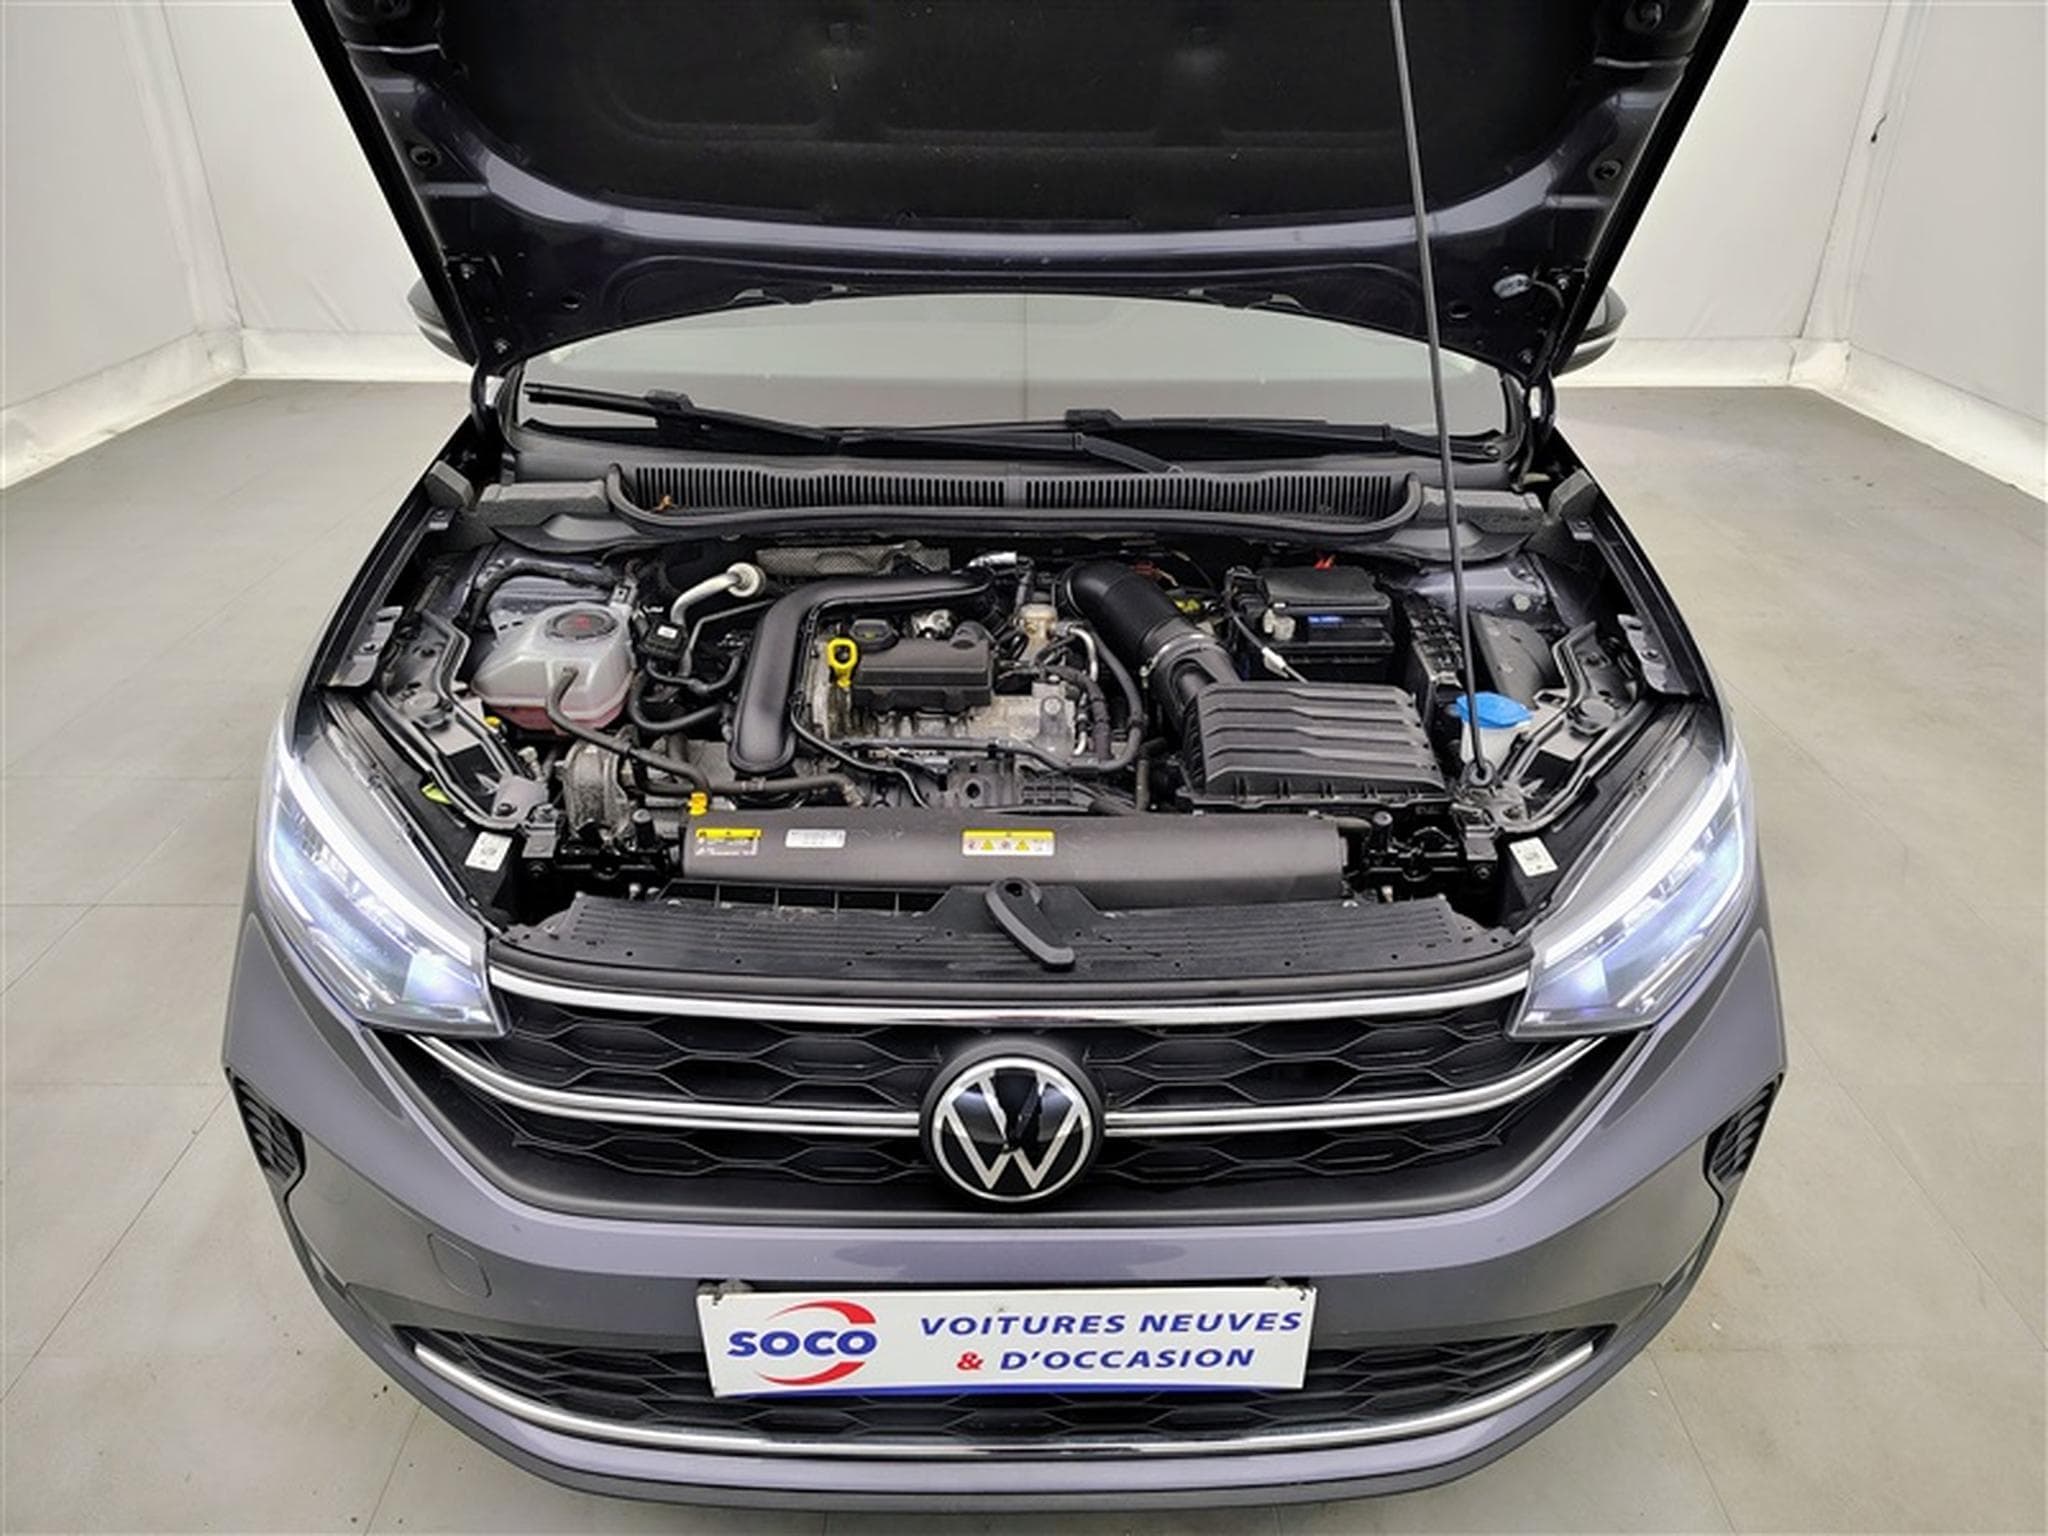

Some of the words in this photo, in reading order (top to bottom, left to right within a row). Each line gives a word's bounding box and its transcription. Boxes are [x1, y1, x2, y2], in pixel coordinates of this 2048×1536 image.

[920, 1314, 1125, 1336] VOITURES
[1138, 1311, 1302, 1333] NEUVES
[727, 1329, 878, 1358] SOCO
[955, 1352, 983, 1372] &
[1000, 1348, 1255, 1371] D'OCCASION
